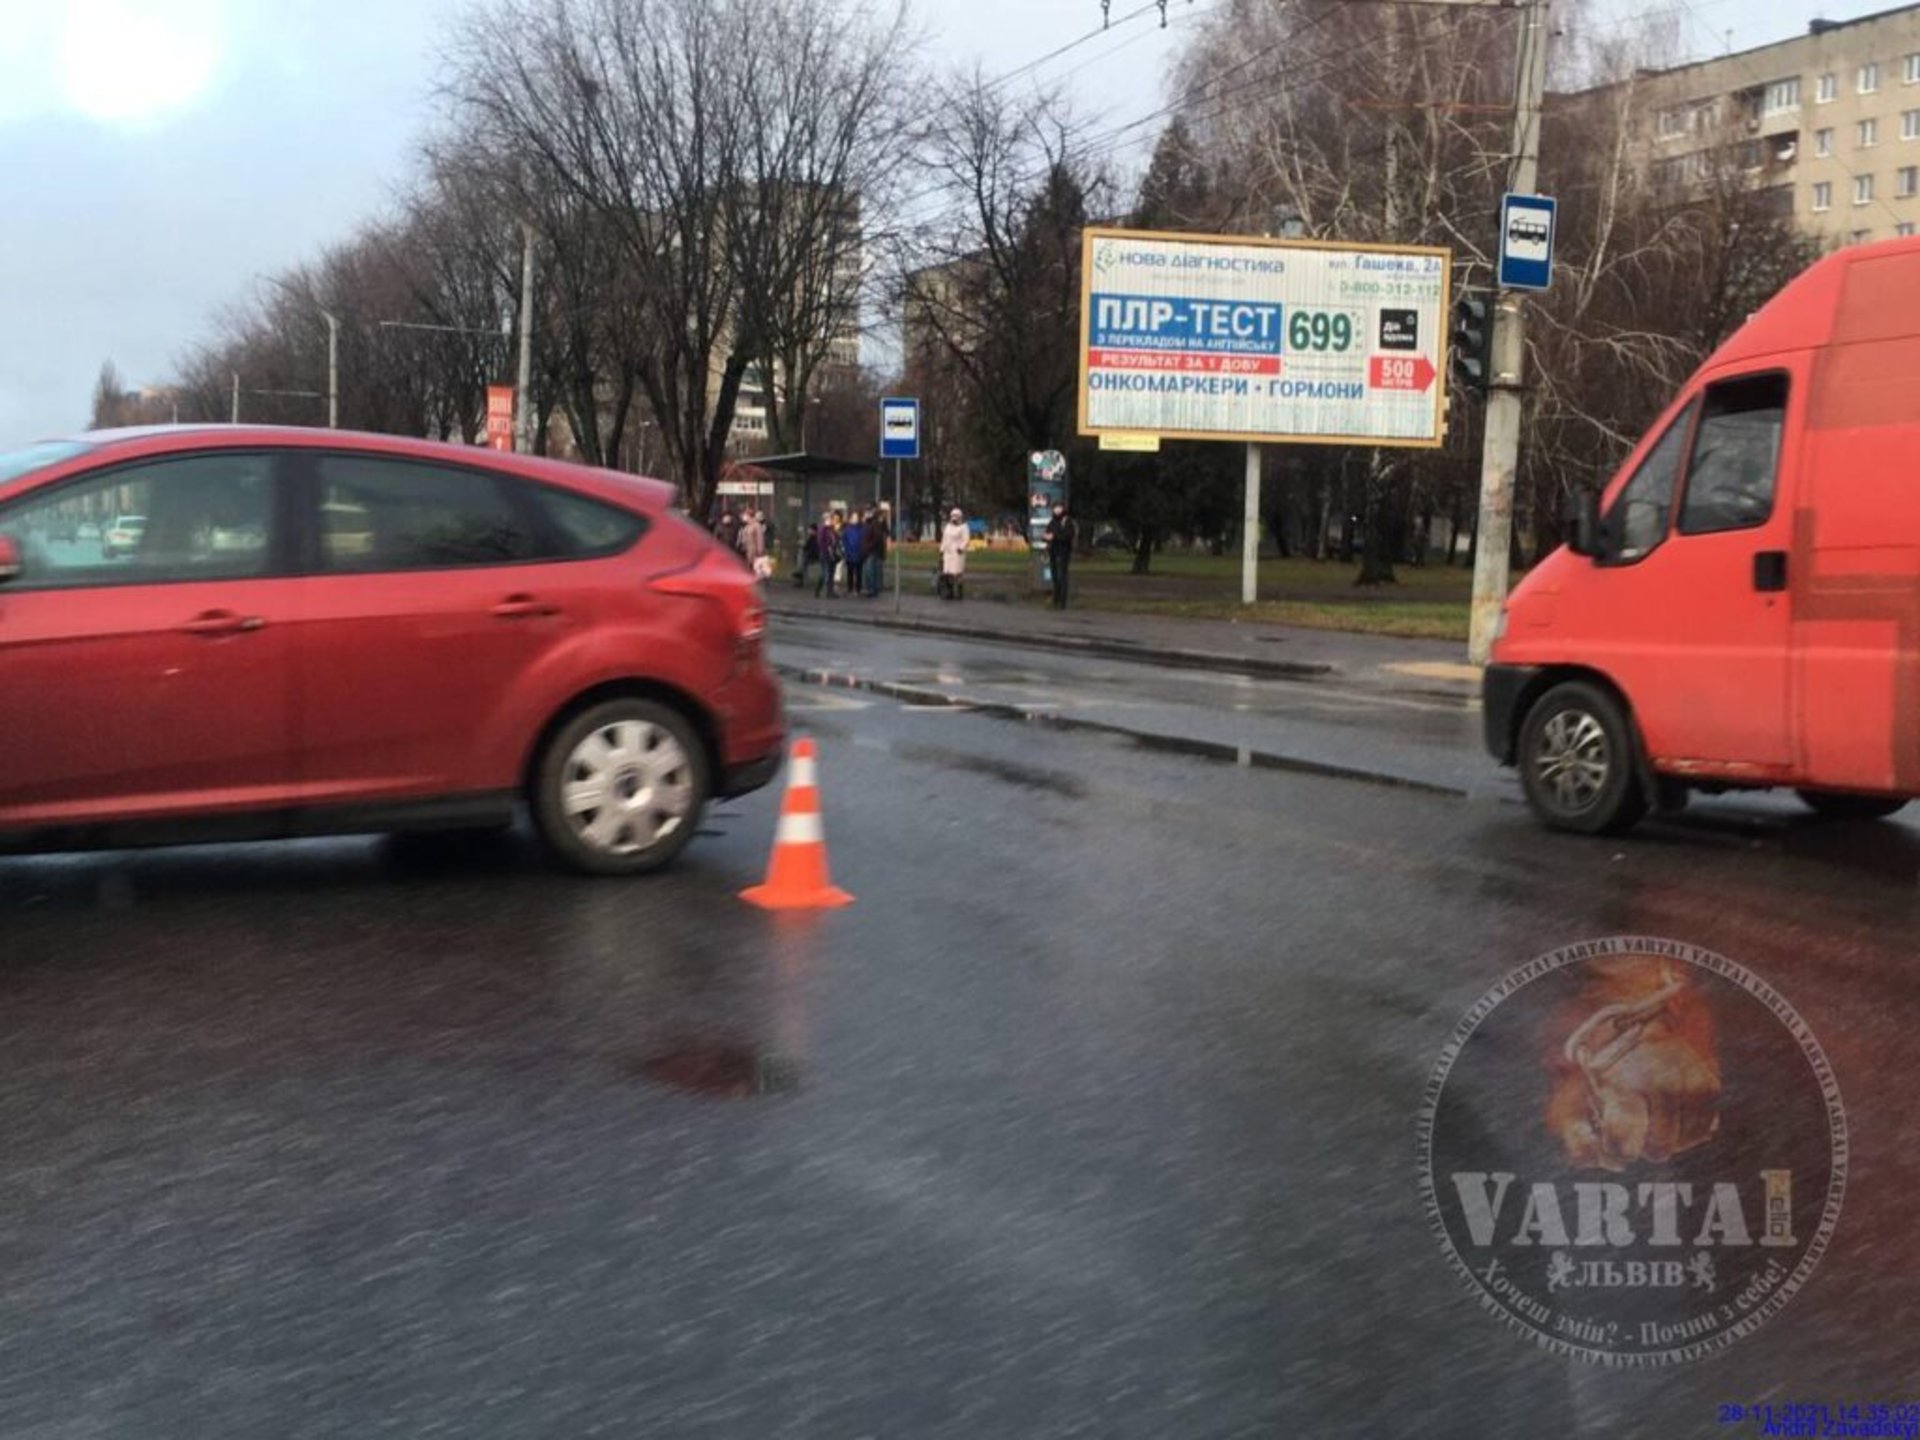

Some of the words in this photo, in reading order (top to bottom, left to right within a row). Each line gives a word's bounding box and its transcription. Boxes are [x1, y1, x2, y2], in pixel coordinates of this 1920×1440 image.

[1098, 298, 1276, 337] ПЛР-ТЕСТ
[1101, 351, 1181, 368] РЕЗУЛЬТАТ
[1185, 356, 1203, 369] ЗА
[1208, 357, 1216, 369] 1
[1381, 360, 1414, 379] 500
[1088, 372, 1248, 395] ОНКОМАРКЕРИ
[1269, 380, 1363, 399] ГОРМОНИ
